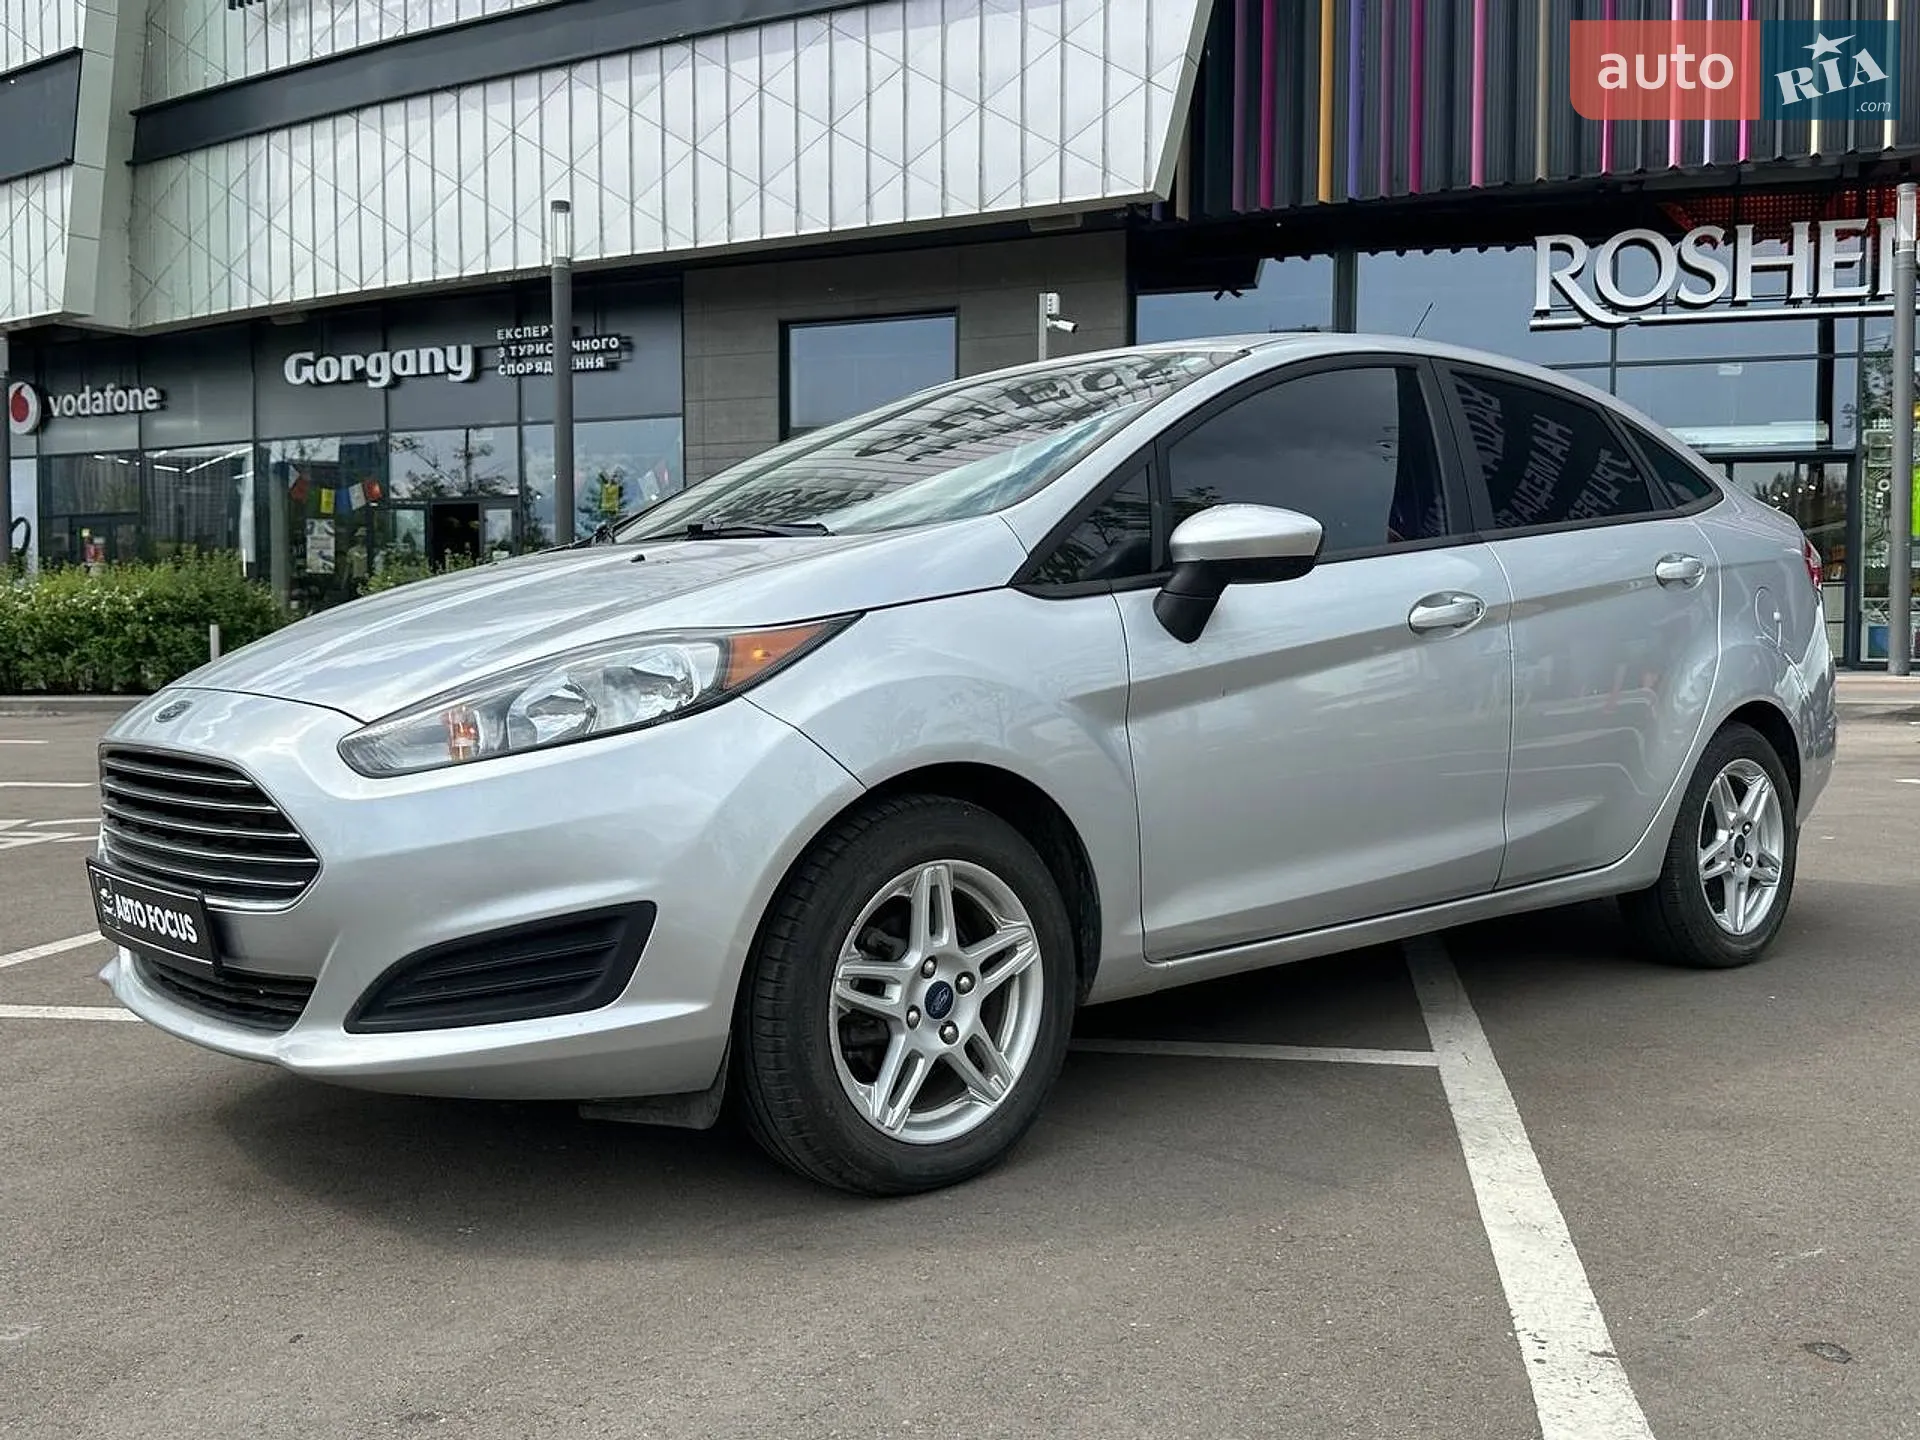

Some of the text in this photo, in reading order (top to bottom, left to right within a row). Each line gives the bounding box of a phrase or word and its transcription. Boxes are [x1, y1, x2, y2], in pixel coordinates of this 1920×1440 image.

[496, 324, 553, 341] ЕКСПЕР
[509, 336, 620, 358] ТУРИСЧНОГО
[284, 343, 475, 388] Gorgany
[498, 357, 605, 376] СПОРЯДННЯ
[48, 383, 158, 417] vodafone
[146, 904, 198, 944] FOCUS
